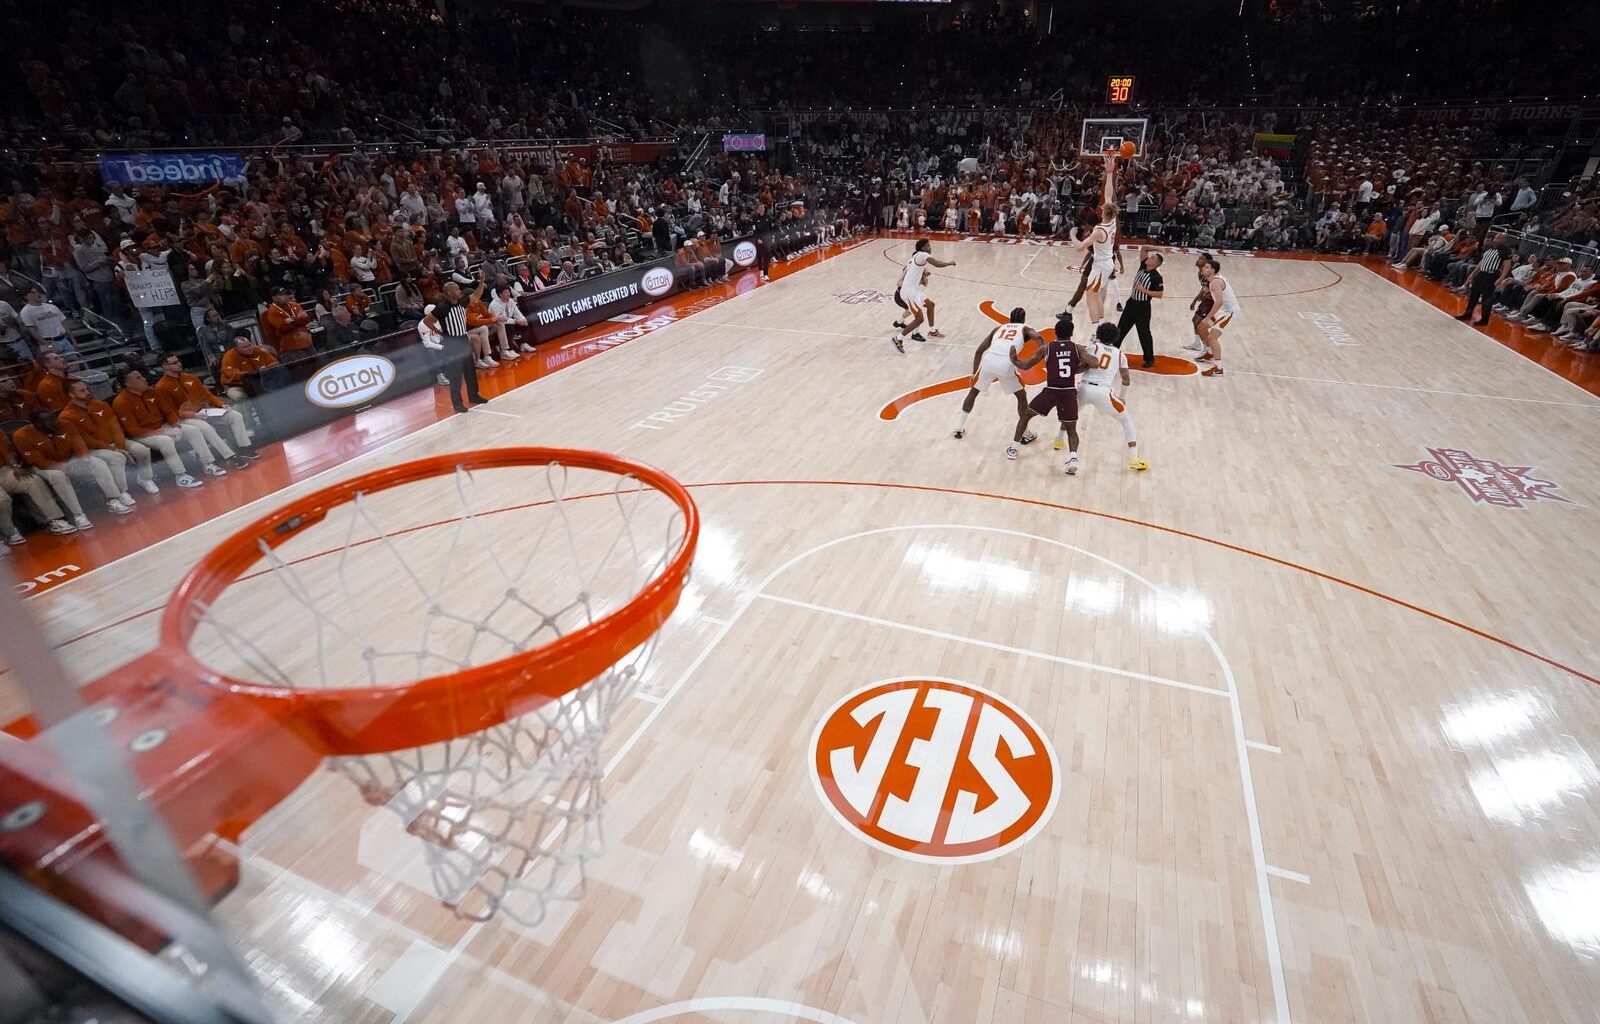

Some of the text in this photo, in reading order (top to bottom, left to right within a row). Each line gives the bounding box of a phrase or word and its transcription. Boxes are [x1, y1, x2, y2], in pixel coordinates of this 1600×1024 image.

[1110, 78, 1132, 87] 20:00
[1111, 87, 1128, 101] 30
[646, 275, 671, 290] COTTON
[150, 287, 176, 301] HIPS
[536, 282, 639, 326] TODAY'S GAME PRESENTED BY
[998, 329, 1018, 340] 12
[1056, 350, 1071, 358] LANE
[1099, 353, 1112, 370] 0
[1058, 358, 1071, 378] 5
[317, 364, 385, 400] COTTON
[629, 382, 728, 430] TRUIST
[829, 687, 1036, 845] SEC
